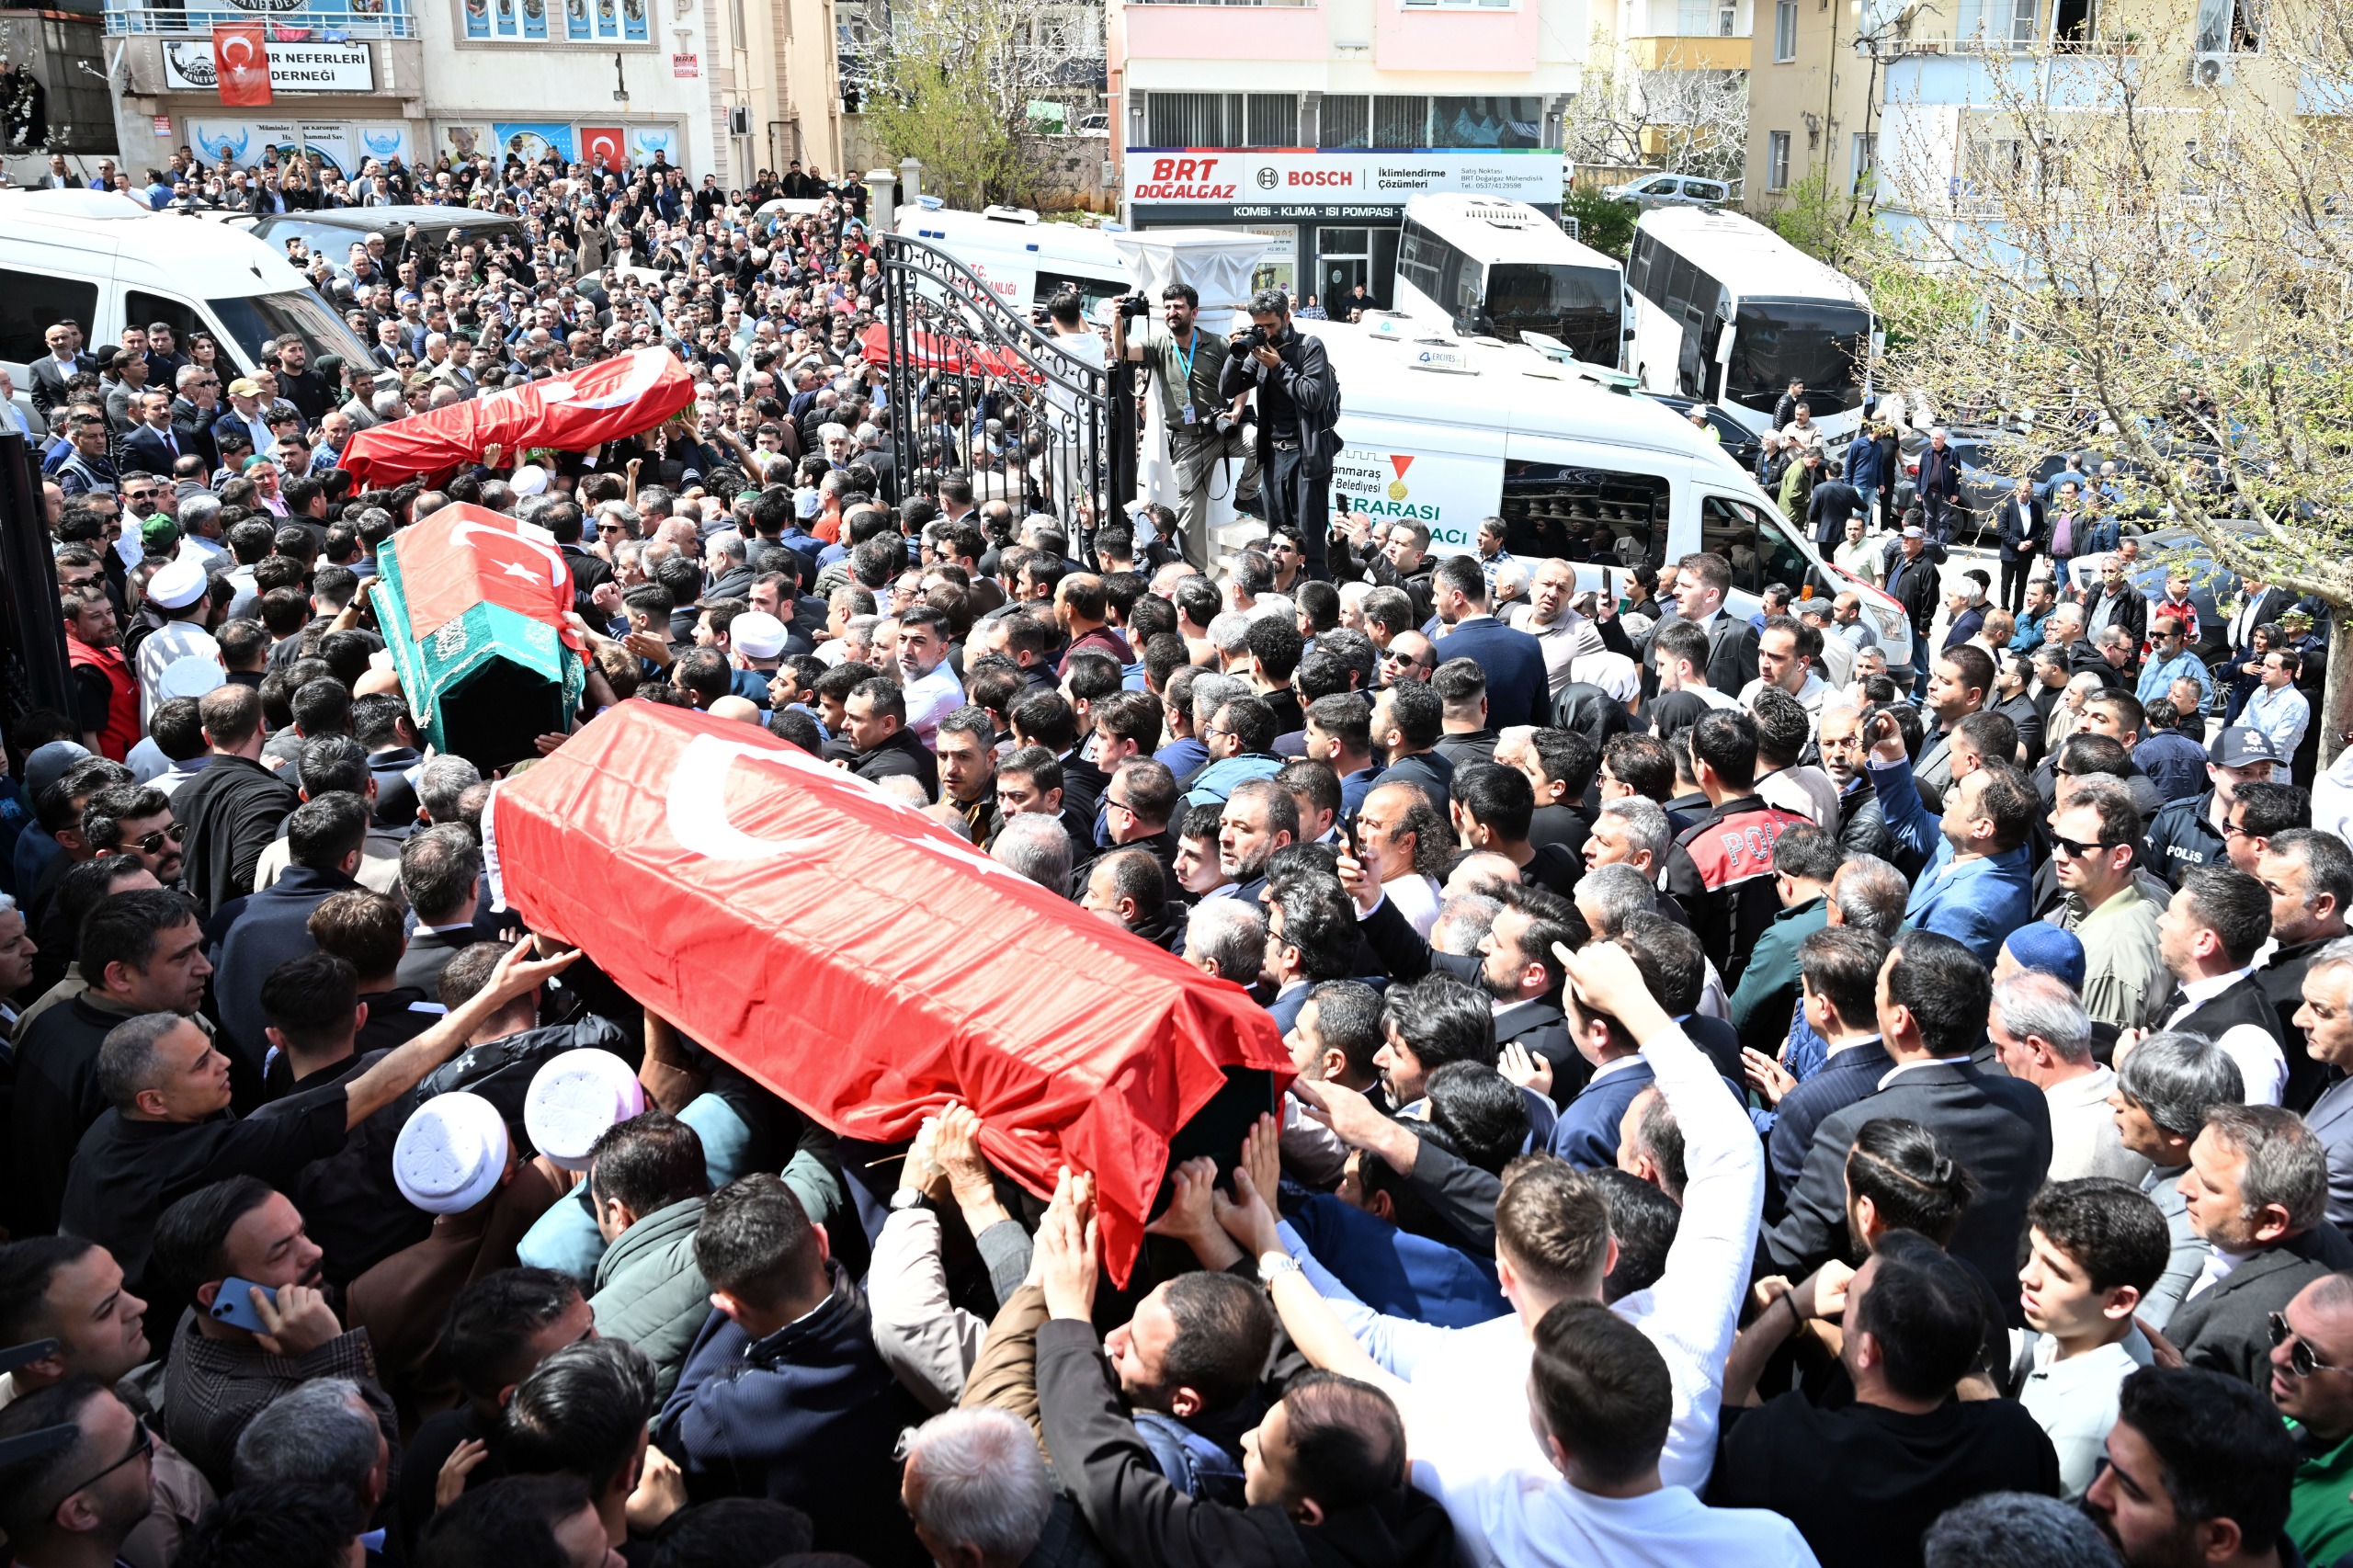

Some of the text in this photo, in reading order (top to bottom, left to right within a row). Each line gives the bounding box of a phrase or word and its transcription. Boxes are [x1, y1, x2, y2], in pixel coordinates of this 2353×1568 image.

[286, 52, 366, 64] NEFERLERİ
[271, 69, 335, 81] DERNEĞİ
[1153, 158, 1219, 181] BRT
[1378, 166, 1446, 177] İklimlendirme
[1288, 171, 1352, 186] BOSCH
[1378, 179, 1428, 190] Çözümleri
[1134, 181, 1237, 199] DOĞALGAZ
[1325, 207, 1339, 217] ISI
[1342, 207, 1393, 217] POMPASI
[1432, 353, 1456, 363] ERCİYES
[1333, 466, 1381, 481] anmaraş
[1336, 478, 1381, 494] Belediyesi
[1430, 528, 1468, 544] ACI
